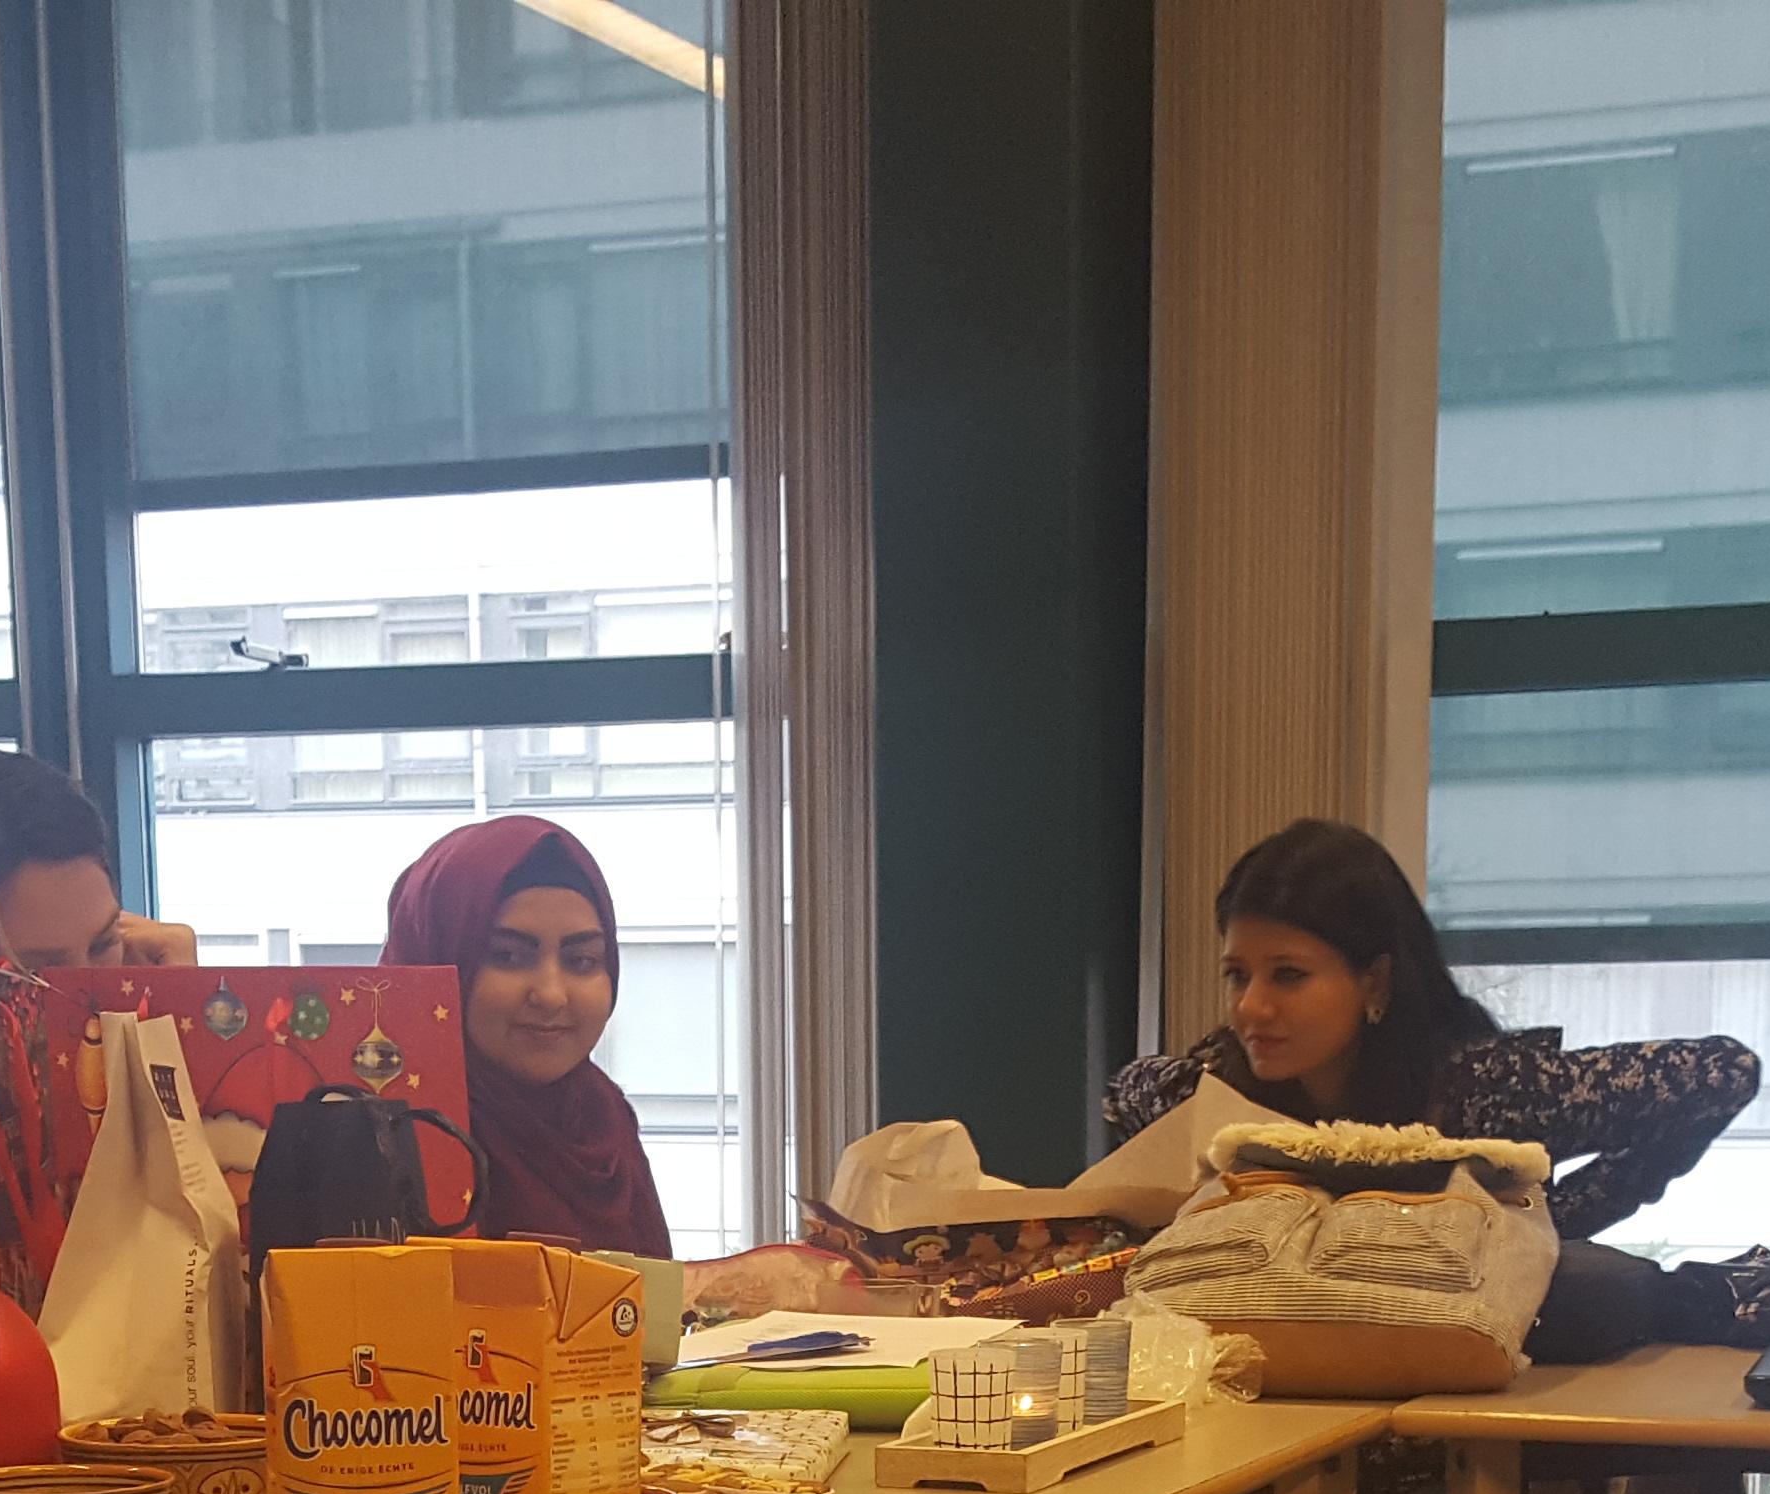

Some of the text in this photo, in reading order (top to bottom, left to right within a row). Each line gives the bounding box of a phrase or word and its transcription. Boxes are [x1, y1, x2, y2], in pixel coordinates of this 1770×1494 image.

[184, 1320, 197, 1350] your
[185, 1387, 198, 1408] our
[458, 1382, 536, 1430] comel
[283, 1395, 449, 1460] Chocomel
[378, 1463, 415, 1474] ECHTE
